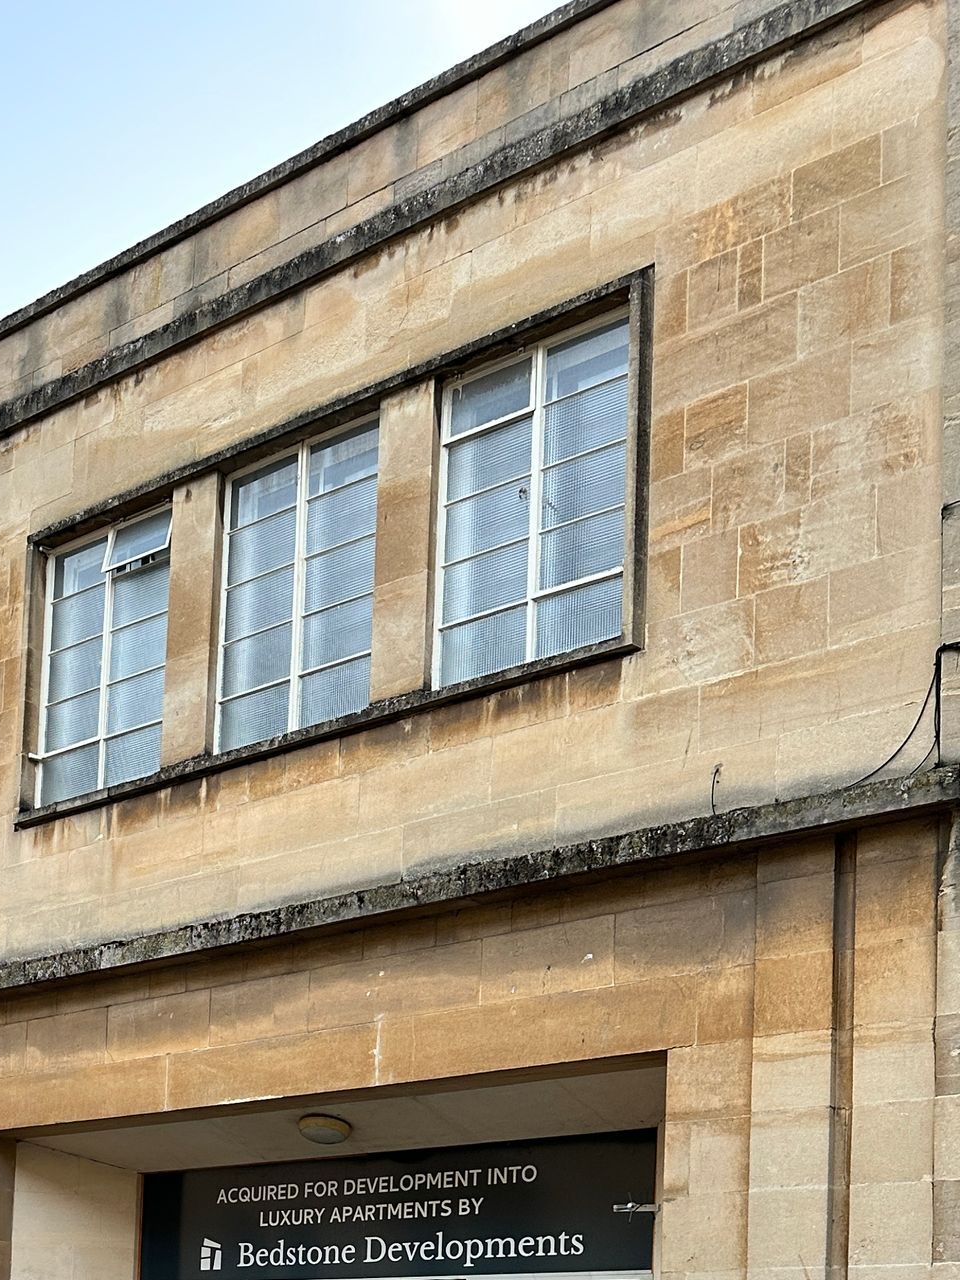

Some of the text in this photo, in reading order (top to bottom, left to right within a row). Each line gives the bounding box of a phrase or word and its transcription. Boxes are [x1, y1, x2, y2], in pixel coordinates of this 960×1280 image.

[217, 1165, 537, 1203] ACQUIRED FOR DEVELOPMENT INTO
[260, 1198, 483, 1226] LUXURY APARTMENTS BY
[237, 1232, 583, 1267] Bedstone Developments
